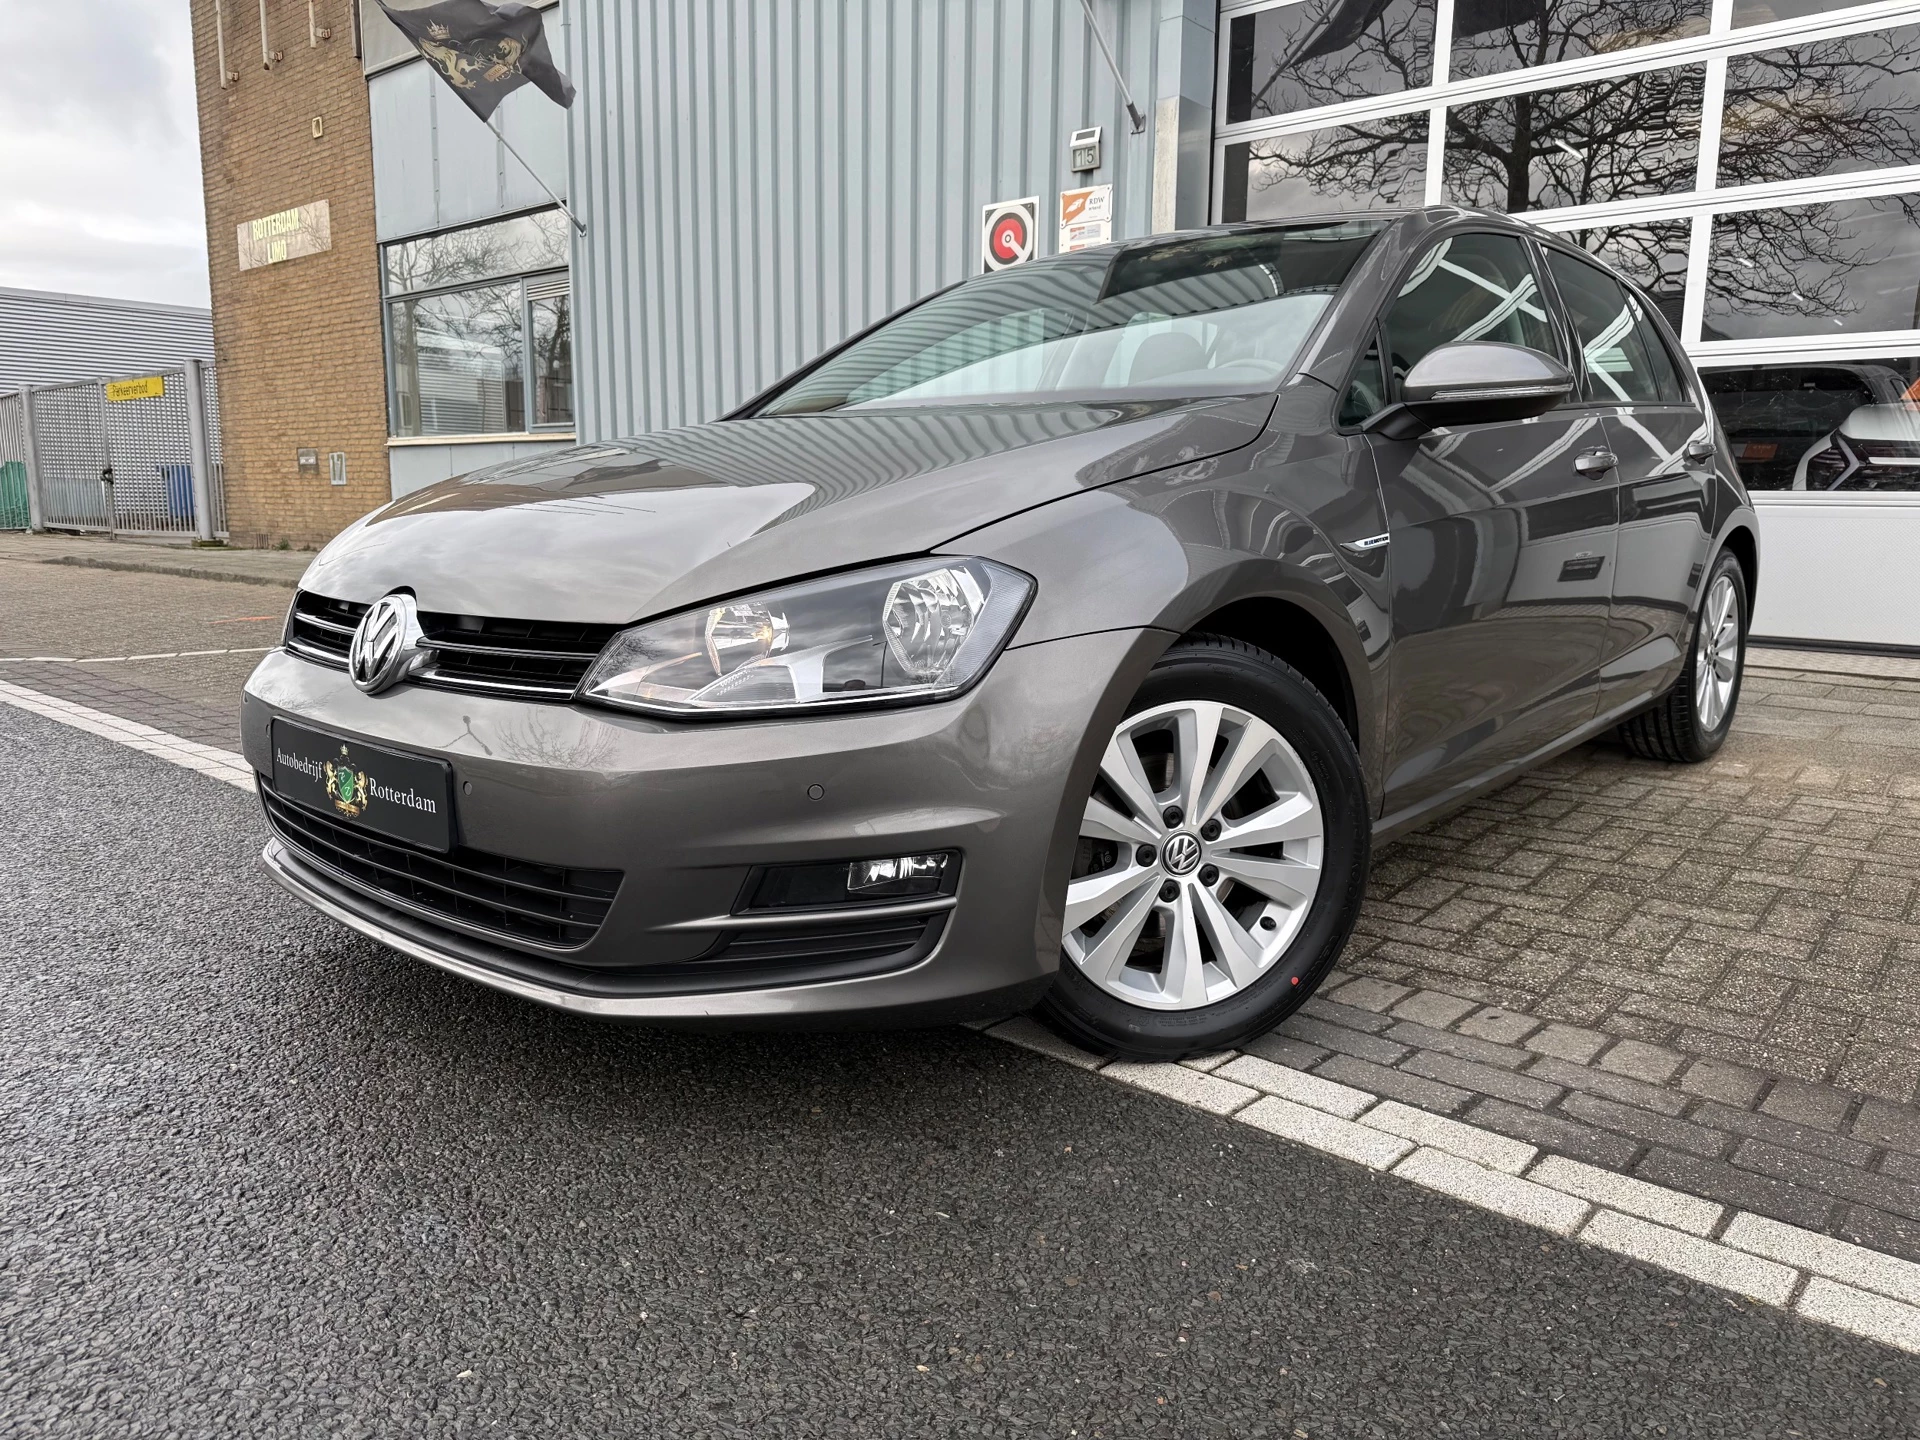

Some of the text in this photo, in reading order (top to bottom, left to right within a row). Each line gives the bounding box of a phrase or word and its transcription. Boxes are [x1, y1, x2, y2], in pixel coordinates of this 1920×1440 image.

[1077, 148, 1094, 166] 15
[252, 207, 299, 241] ROTTERDAM
[267, 240, 287, 264] LIMO
[112, 380, 149, 397] Parkeerverbod
[330, 453, 344, 481] 17
[276, 747, 323, 782] Autobedrijf
[369, 777, 437, 814] Rotterdam
